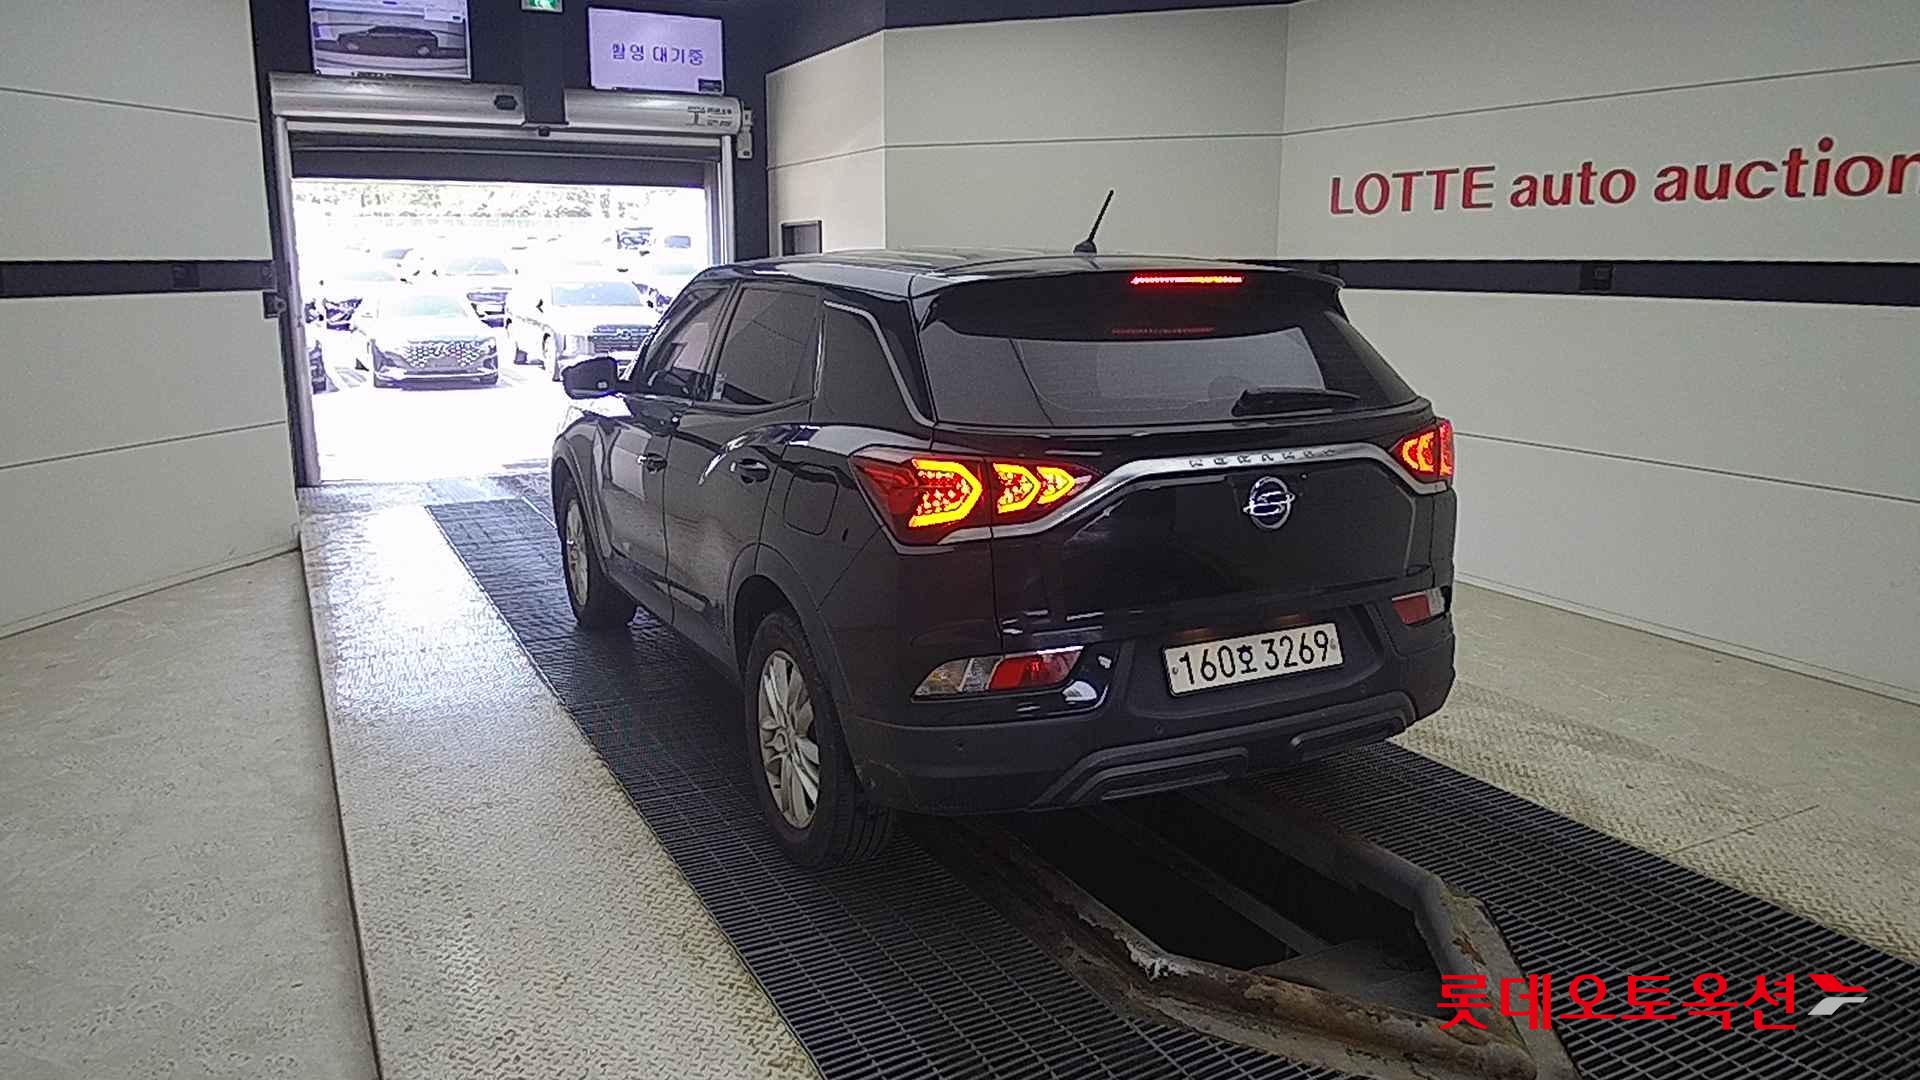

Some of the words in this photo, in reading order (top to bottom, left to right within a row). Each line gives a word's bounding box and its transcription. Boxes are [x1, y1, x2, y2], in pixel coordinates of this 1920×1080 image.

[1330, 165, 1495, 215] LOTTE
[1510, 161, 1636, 208] auto
[1178, 630, 1329, 685] 160호3269
